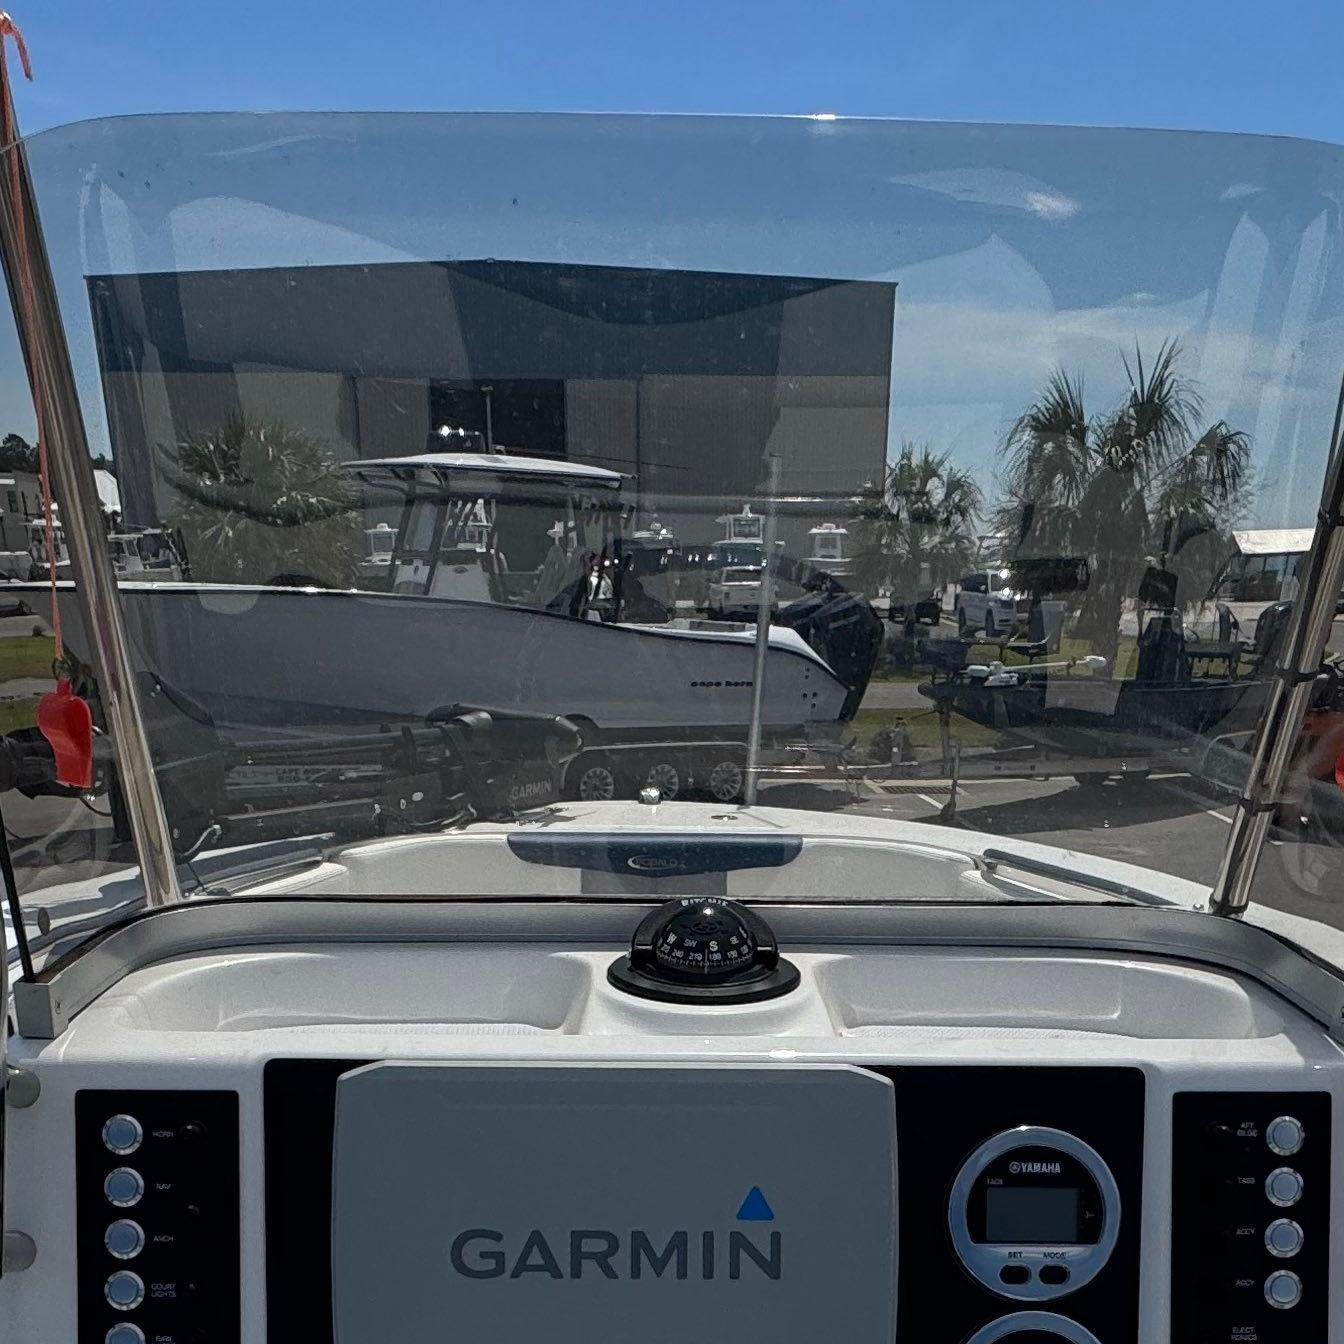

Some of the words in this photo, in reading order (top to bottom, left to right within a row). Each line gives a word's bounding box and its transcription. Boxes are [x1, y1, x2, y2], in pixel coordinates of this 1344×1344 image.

[511, 778, 553, 801] GARMIN
[710, 940, 719, 951] S
[1021, 1162, 1061, 1174] YAMAHA
[450, 1228, 782, 1281] GARMIN
[1007, 1251, 1023, 1259] SET
[1043, 1251, 1067, 1259] MODE
